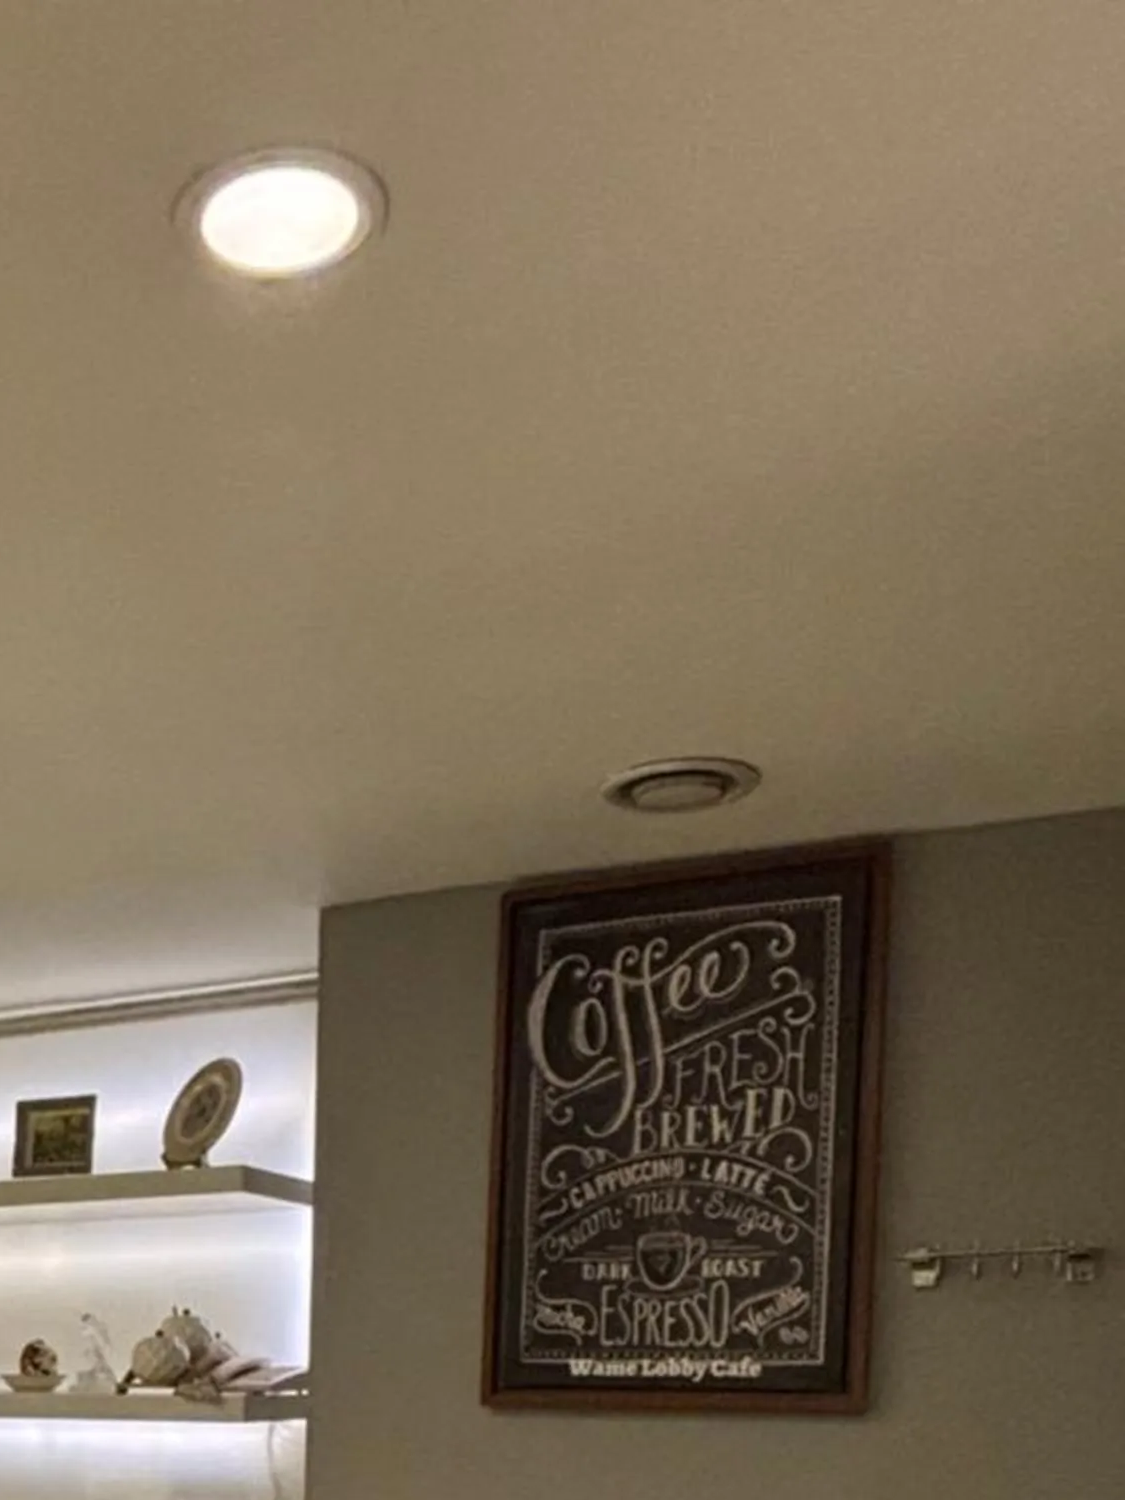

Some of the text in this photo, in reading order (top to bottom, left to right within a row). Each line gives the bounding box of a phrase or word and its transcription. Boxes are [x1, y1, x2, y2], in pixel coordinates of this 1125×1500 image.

[527, 922, 796, 1138] Coffee
[674, 1016, 818, 1109] FRESH
[632, 1086, 795, 1157] BREWED
[570, 1157, 685, 1208] CAPPUCCINO
[703, 1189, 799, 1244] Sugar
[582, 1257, 765, 1281] DARK ROAST
[599, 1279, 730, 1347] ESPRESSO
[569, 1356, 762, 1382] Wame Lobby Cafe
